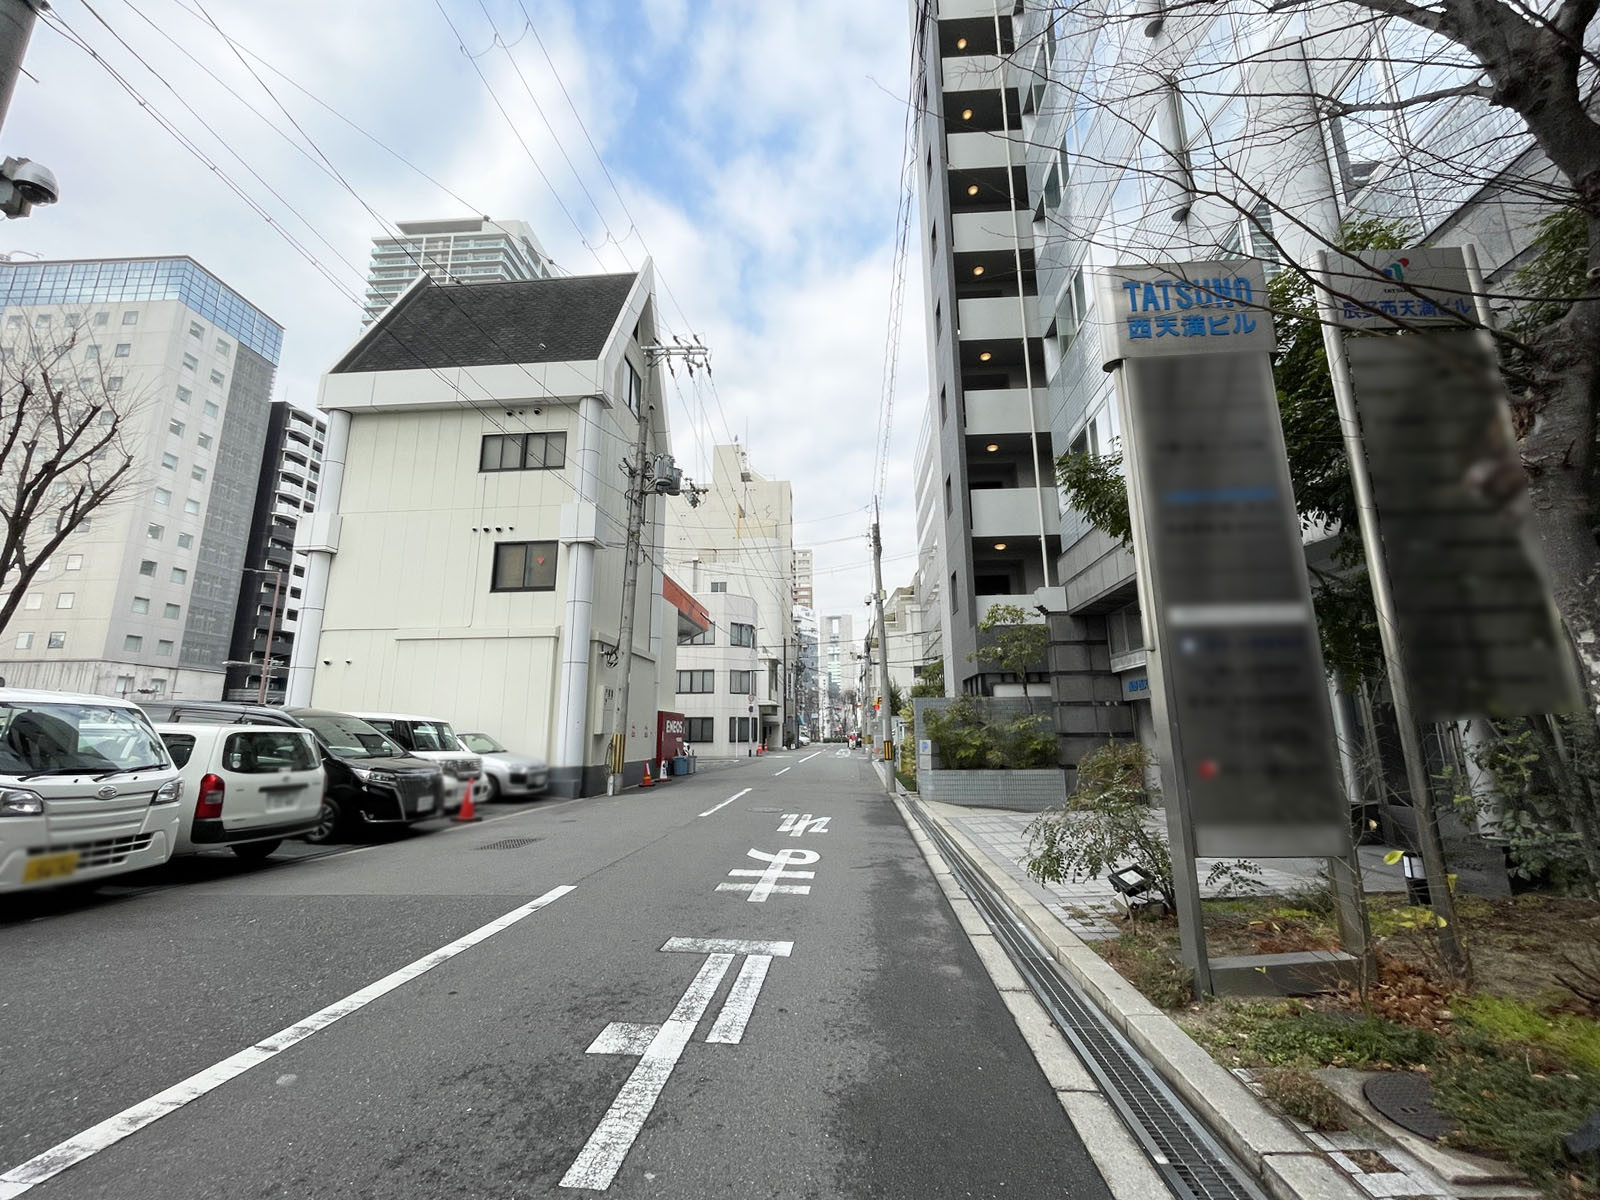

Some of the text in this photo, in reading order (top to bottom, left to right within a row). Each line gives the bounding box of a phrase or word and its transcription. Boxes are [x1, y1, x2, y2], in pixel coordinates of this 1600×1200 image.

[1122, 277, 1253, 312] TATSUNO
[1126, 314, 1257, 340] 西天満ビル
[665, 719, 683, 734] ENEOS
